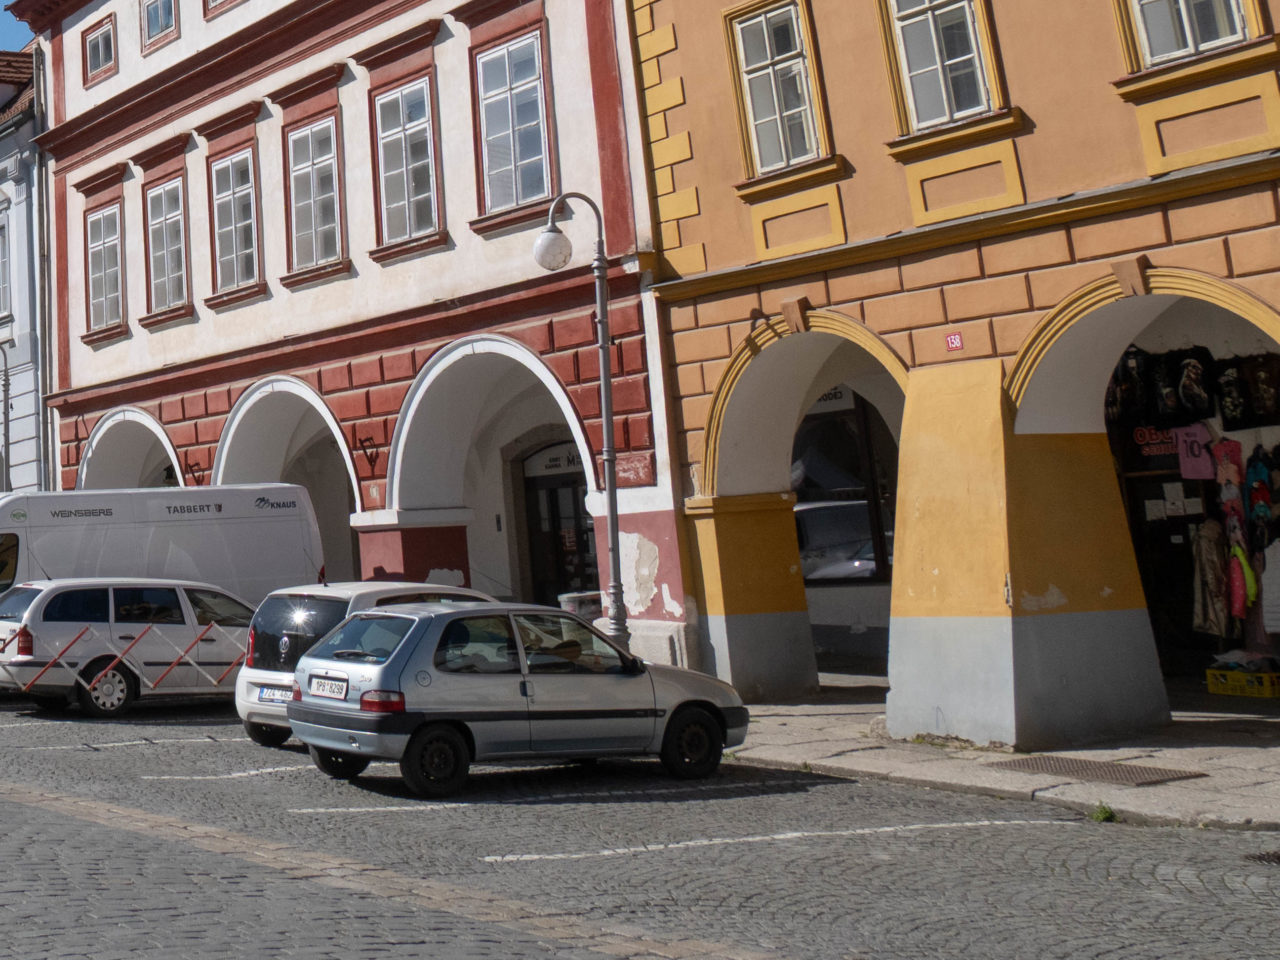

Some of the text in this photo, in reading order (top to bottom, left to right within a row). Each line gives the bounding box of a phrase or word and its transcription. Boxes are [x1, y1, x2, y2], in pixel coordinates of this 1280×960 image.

[947, 334, 961, 348] 138
[1183, 440, 1201, 458] 10
[166, 504, 212, 515] TABBERT
[270, 501, 297, 509] KNAUS
[50, 509, 113, 518] WEINSBERG
[329, 682, 344, 694] 8299
